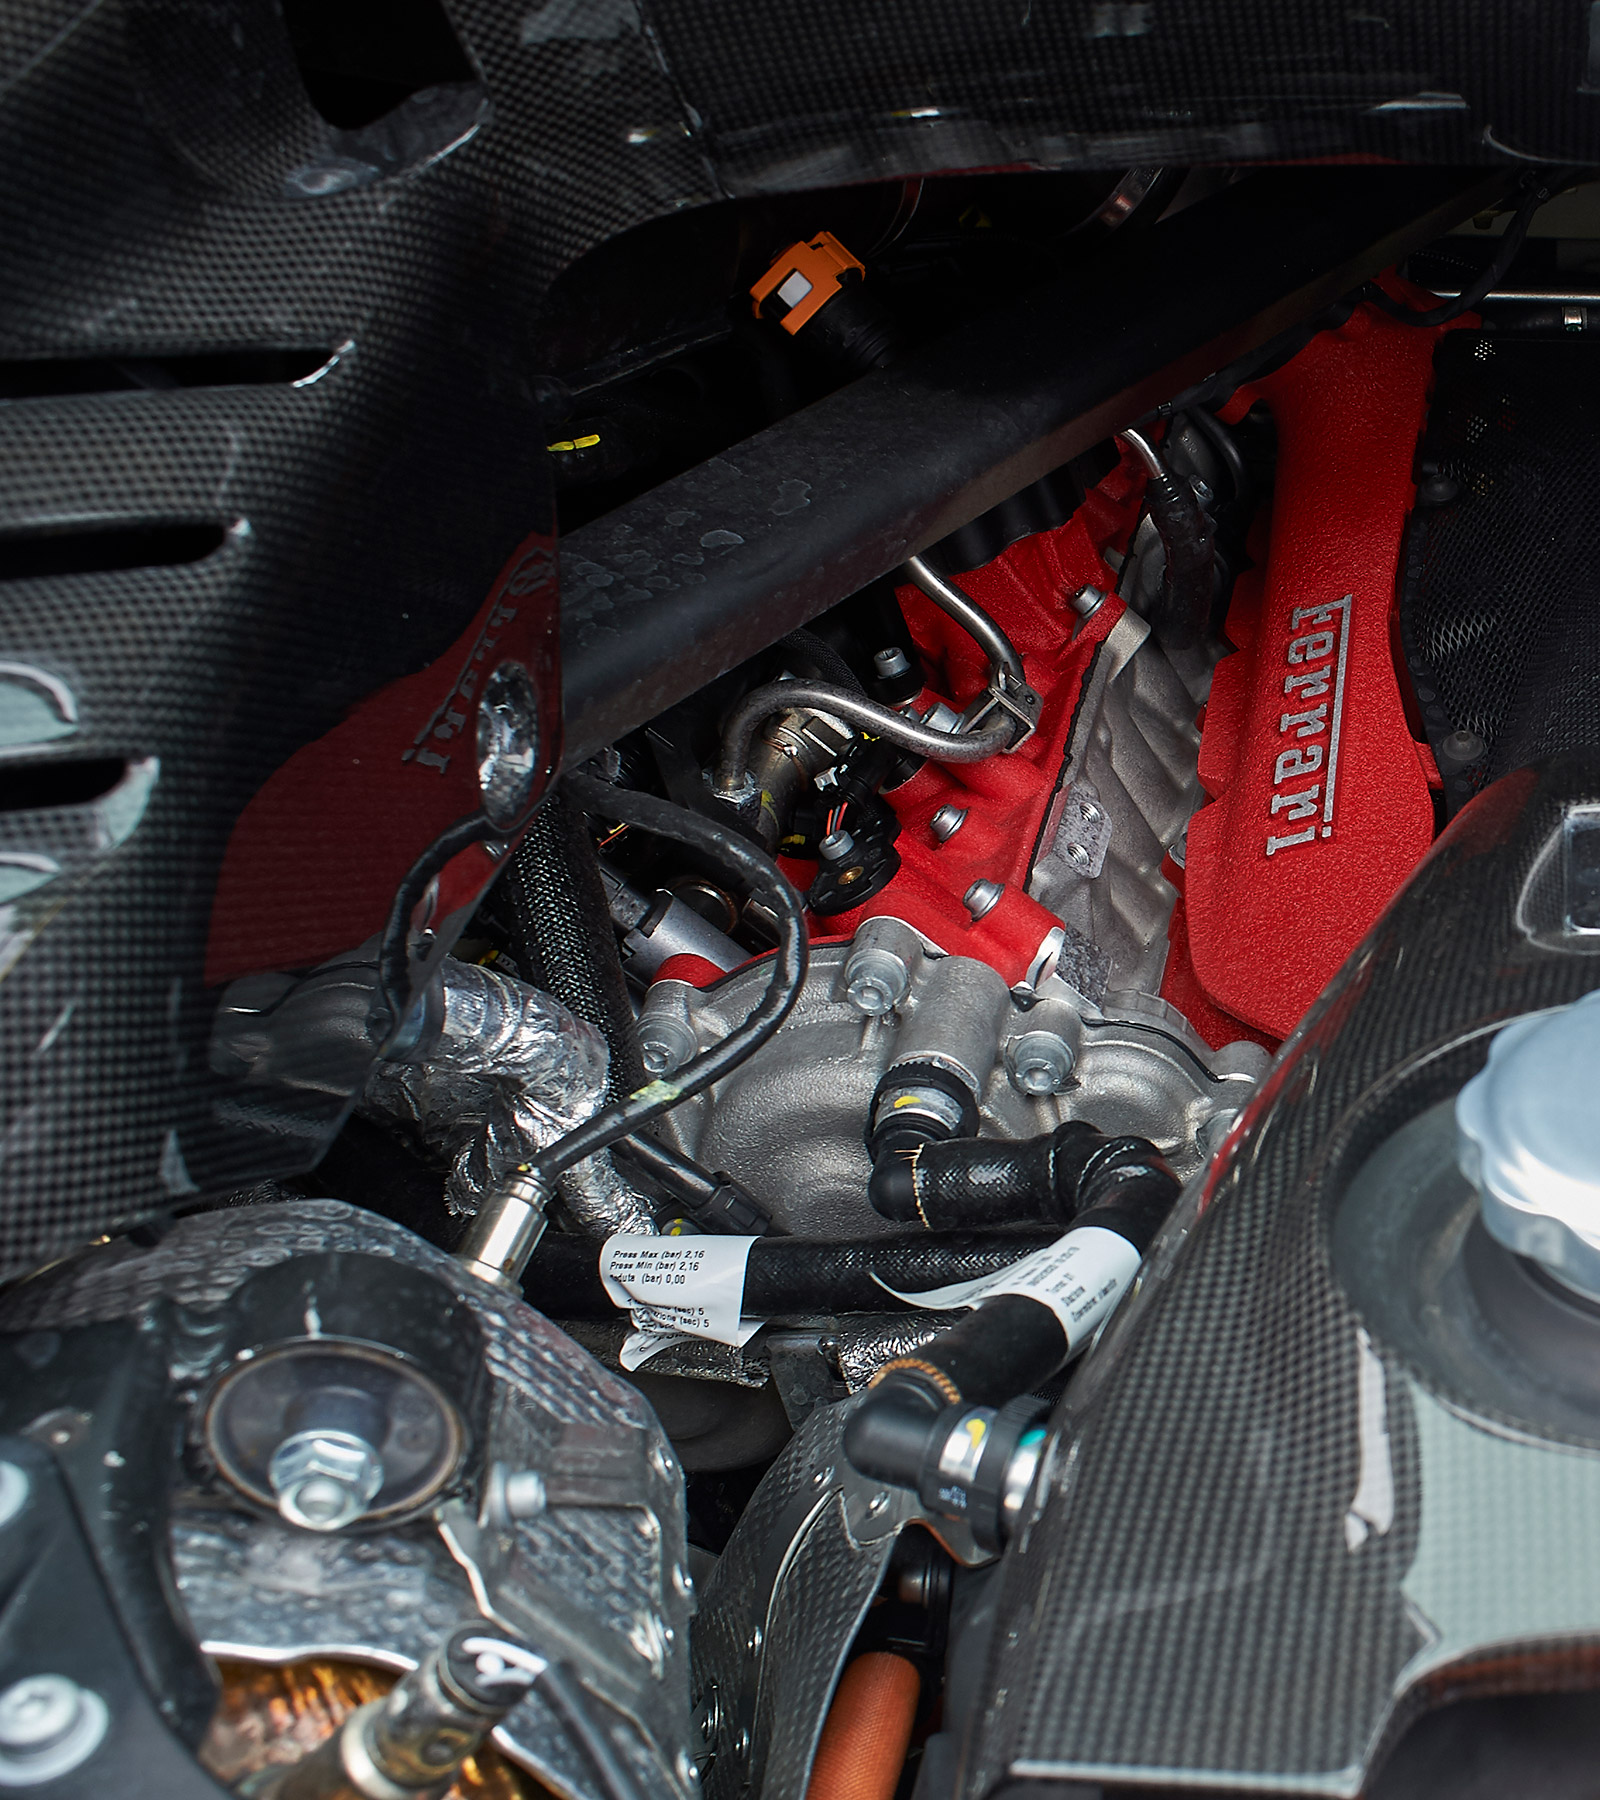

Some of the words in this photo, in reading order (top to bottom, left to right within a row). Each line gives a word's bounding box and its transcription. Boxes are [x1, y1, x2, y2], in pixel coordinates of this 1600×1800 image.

[1265, 593, 1352, 856] Ferrari
[612, 1250, 637, 1258] Press
[640, 1250, 658, 1258] Max
[661, 1250, 682, 1260] (bar)
[684, 1250, 705, 1259] 2,16
[609, 1261, 633, 1270] Press
[655, 1262, 677, 1272] (bar)
[679, 1261, 700, 1271] 2,16
[641, 1273, 663, 1284] (bar)
[665, 1274, 686, 1285] 0,00
[698, 1307, 705, 1316] 5
[703, 1318, 710, 1328] 5
